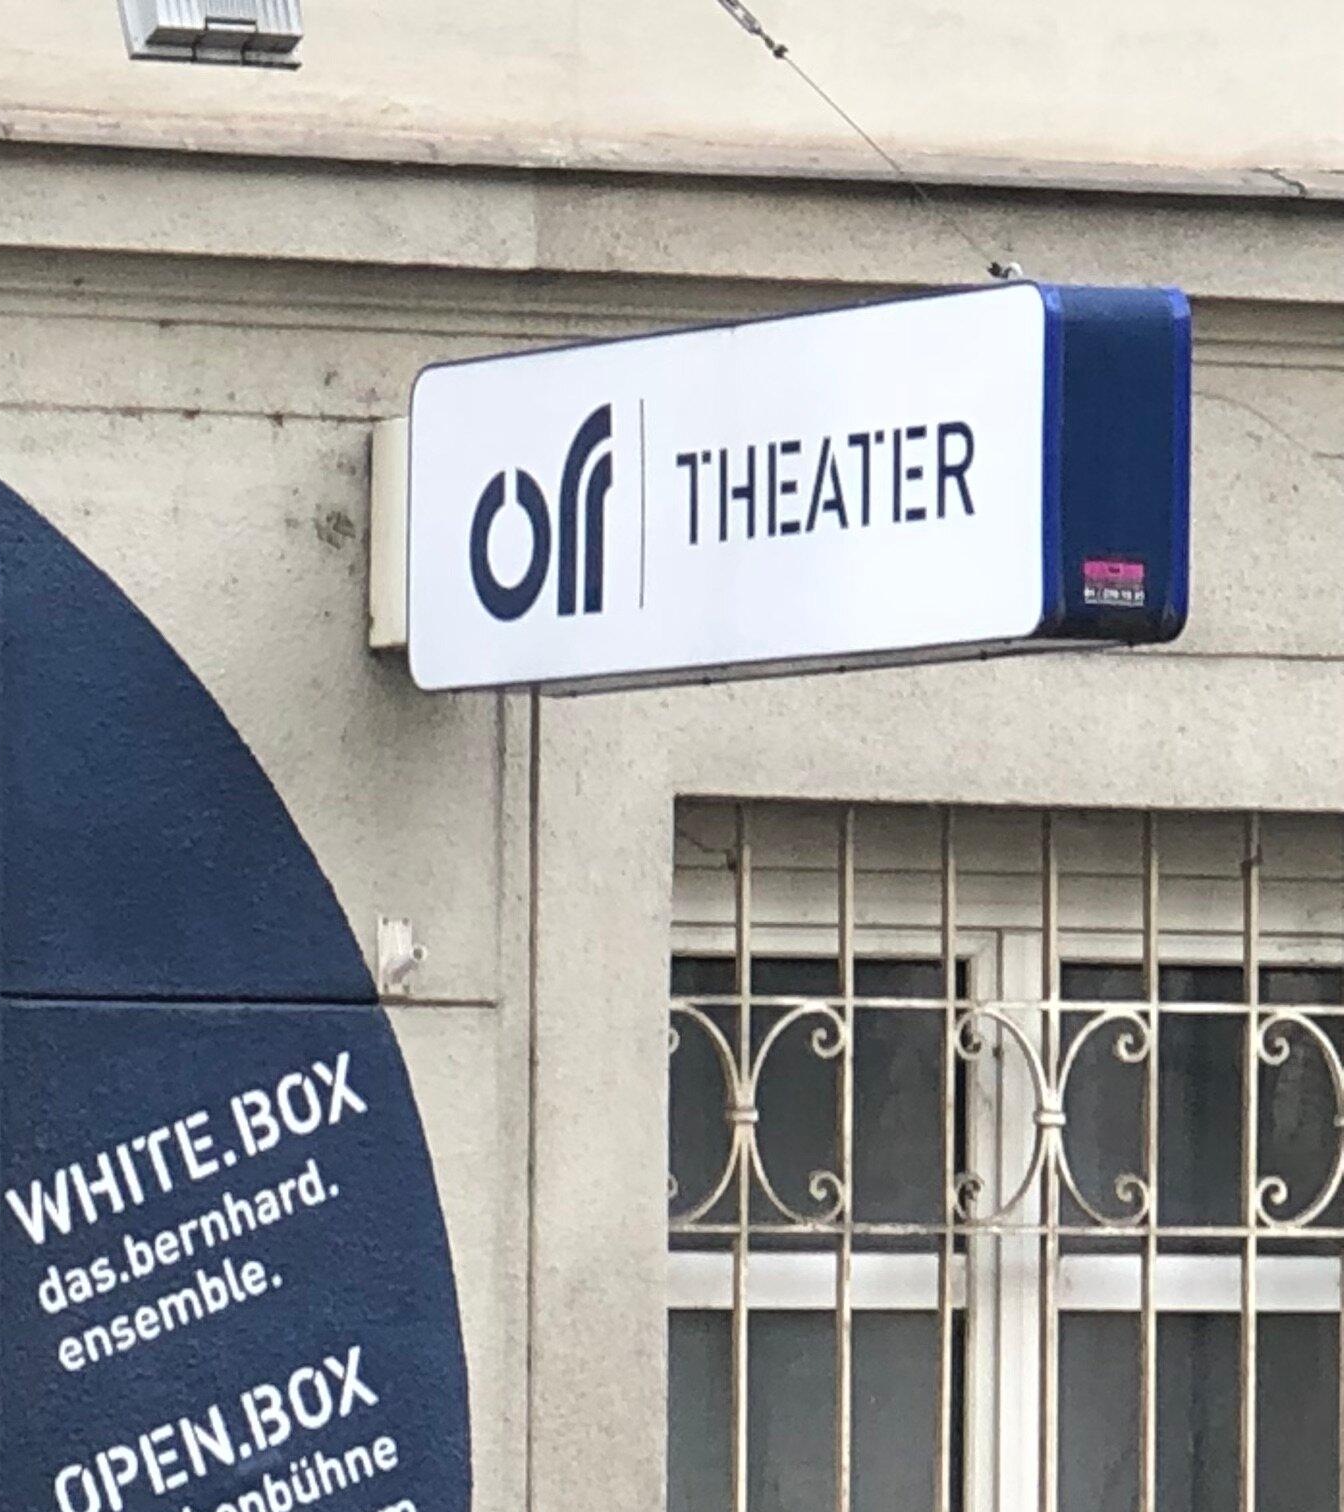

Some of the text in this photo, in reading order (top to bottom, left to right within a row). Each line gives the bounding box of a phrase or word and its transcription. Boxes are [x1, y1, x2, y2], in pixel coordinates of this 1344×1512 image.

[677, 421, 976, 545] THEATER
[5, 1051, 367, 1245] WHITE.BOX
[38, 1159, 339, 1313] das.bernhard.
[58, 1257, 283, 1371] ensemble.
